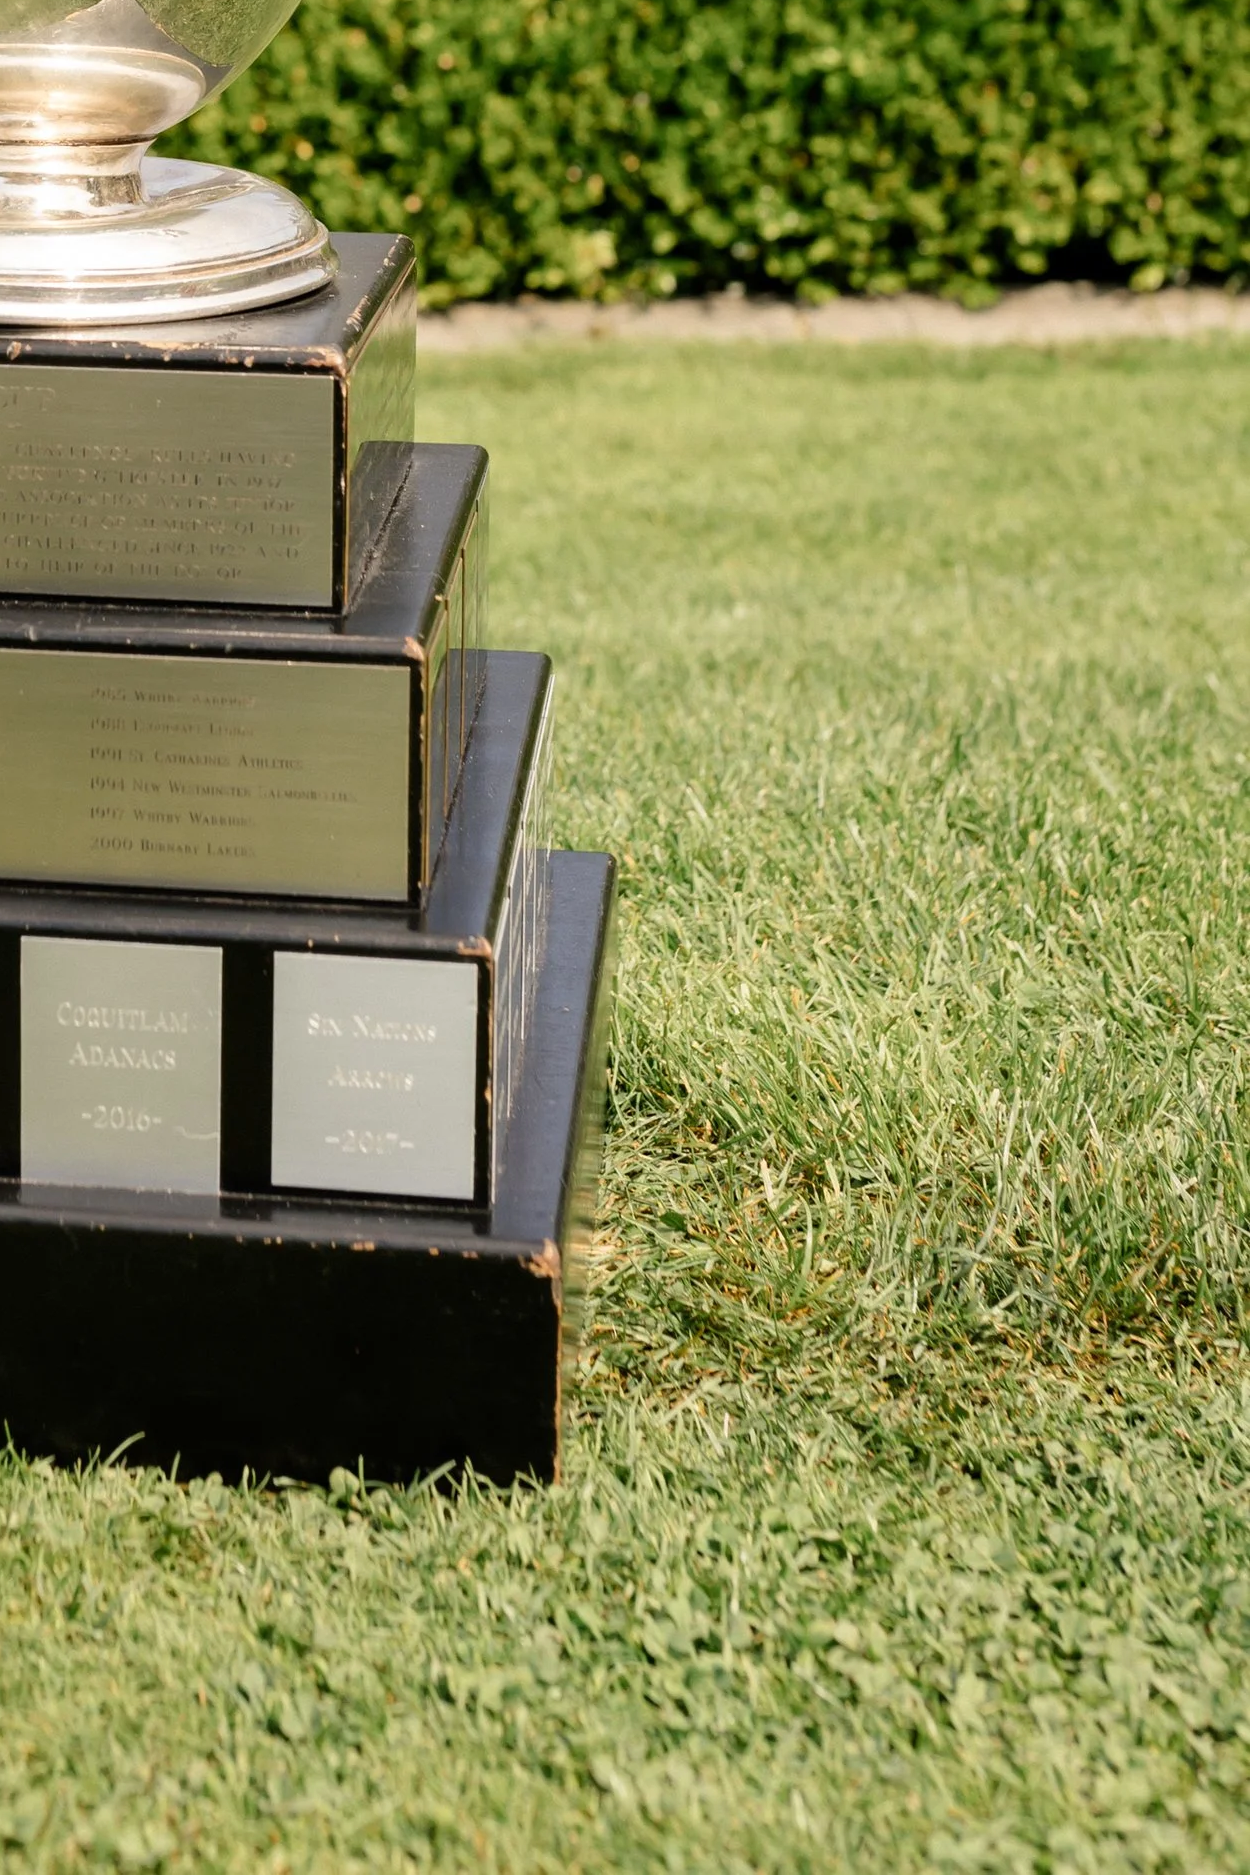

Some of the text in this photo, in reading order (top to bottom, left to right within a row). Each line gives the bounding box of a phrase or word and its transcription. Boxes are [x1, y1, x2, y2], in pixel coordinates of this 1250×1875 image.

[238, 754, 304, 770] ATHLETICS
[132, 778, 160, 793] NEW
[133, 808, 181, 824] WHITBY
[90, 836, 133, 851] 2000
[140, 838, 200, 855] BURNABY
[56, 1001, 188, 1033] COQUITLAM
[308, 1013, 437, 1043] SIX NATIONS
[68, 1041, 176, 1070] ADANACS
[82, 1105, 162, 1132] -2016-
